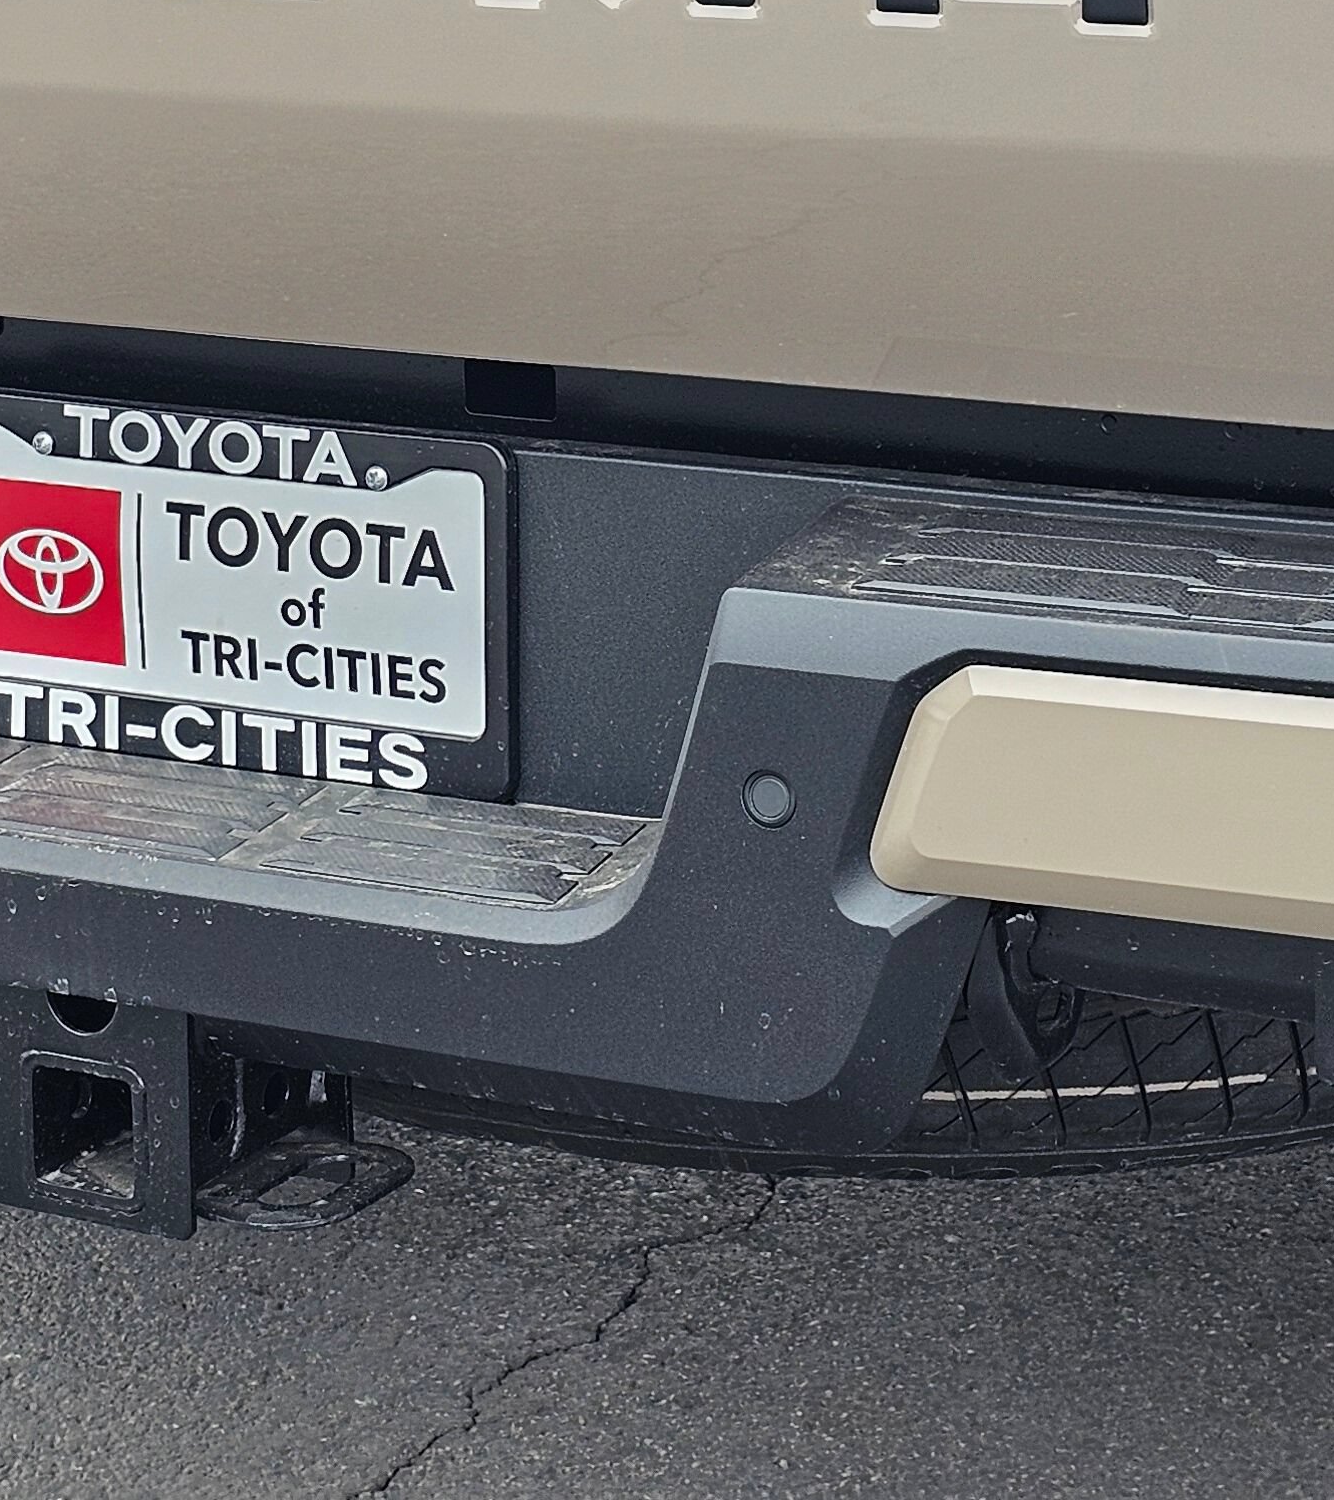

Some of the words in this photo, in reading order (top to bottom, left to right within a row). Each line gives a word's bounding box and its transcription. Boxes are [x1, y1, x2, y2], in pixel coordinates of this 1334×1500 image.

[63, 403, 357, 487] TOYOTA
[166, 500, 455, 591] TOYOTA
[280, 588, 325, 629] of
[180, 630, 446, 703] TRI-CITIES
